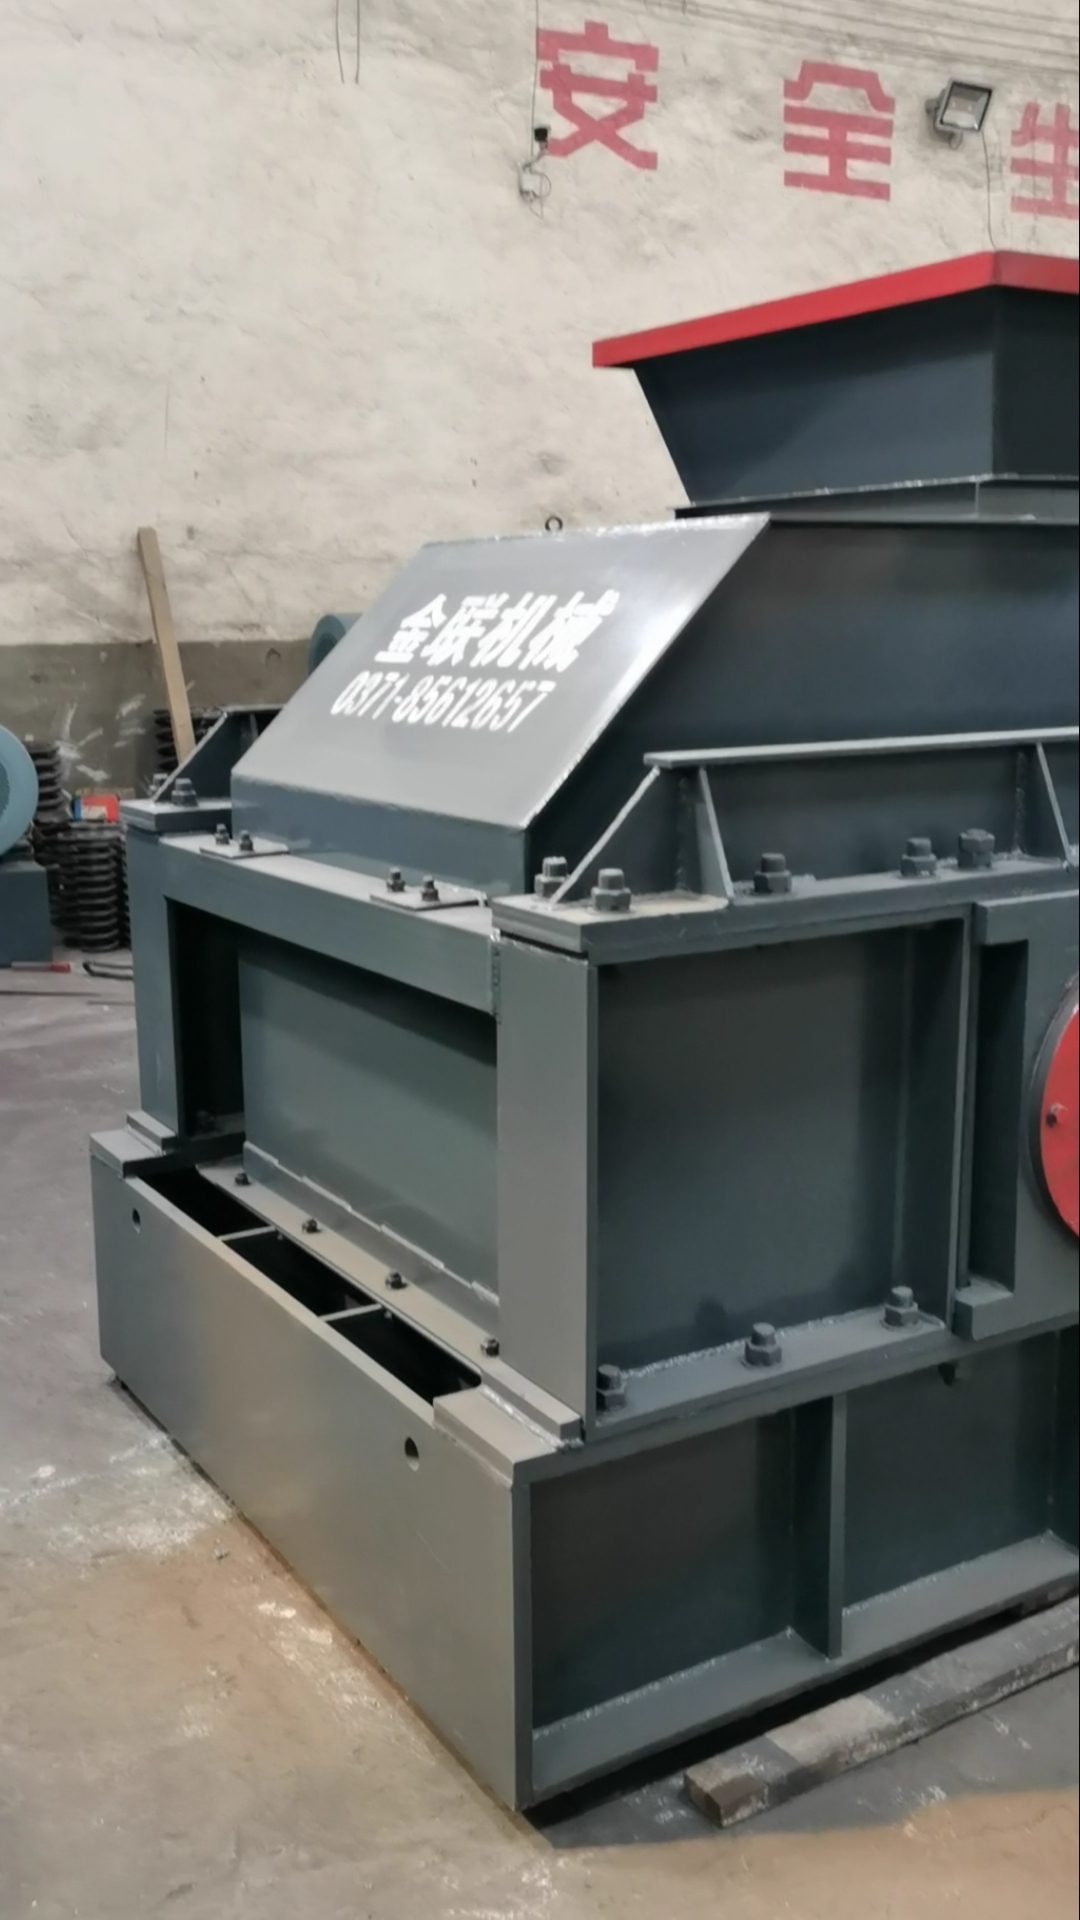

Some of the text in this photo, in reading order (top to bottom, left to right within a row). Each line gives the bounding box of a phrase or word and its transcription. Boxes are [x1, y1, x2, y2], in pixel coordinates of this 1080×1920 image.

[374, 589, 620, 672] 金联机械
[330, 670, 557, 733] 0371-85612657
